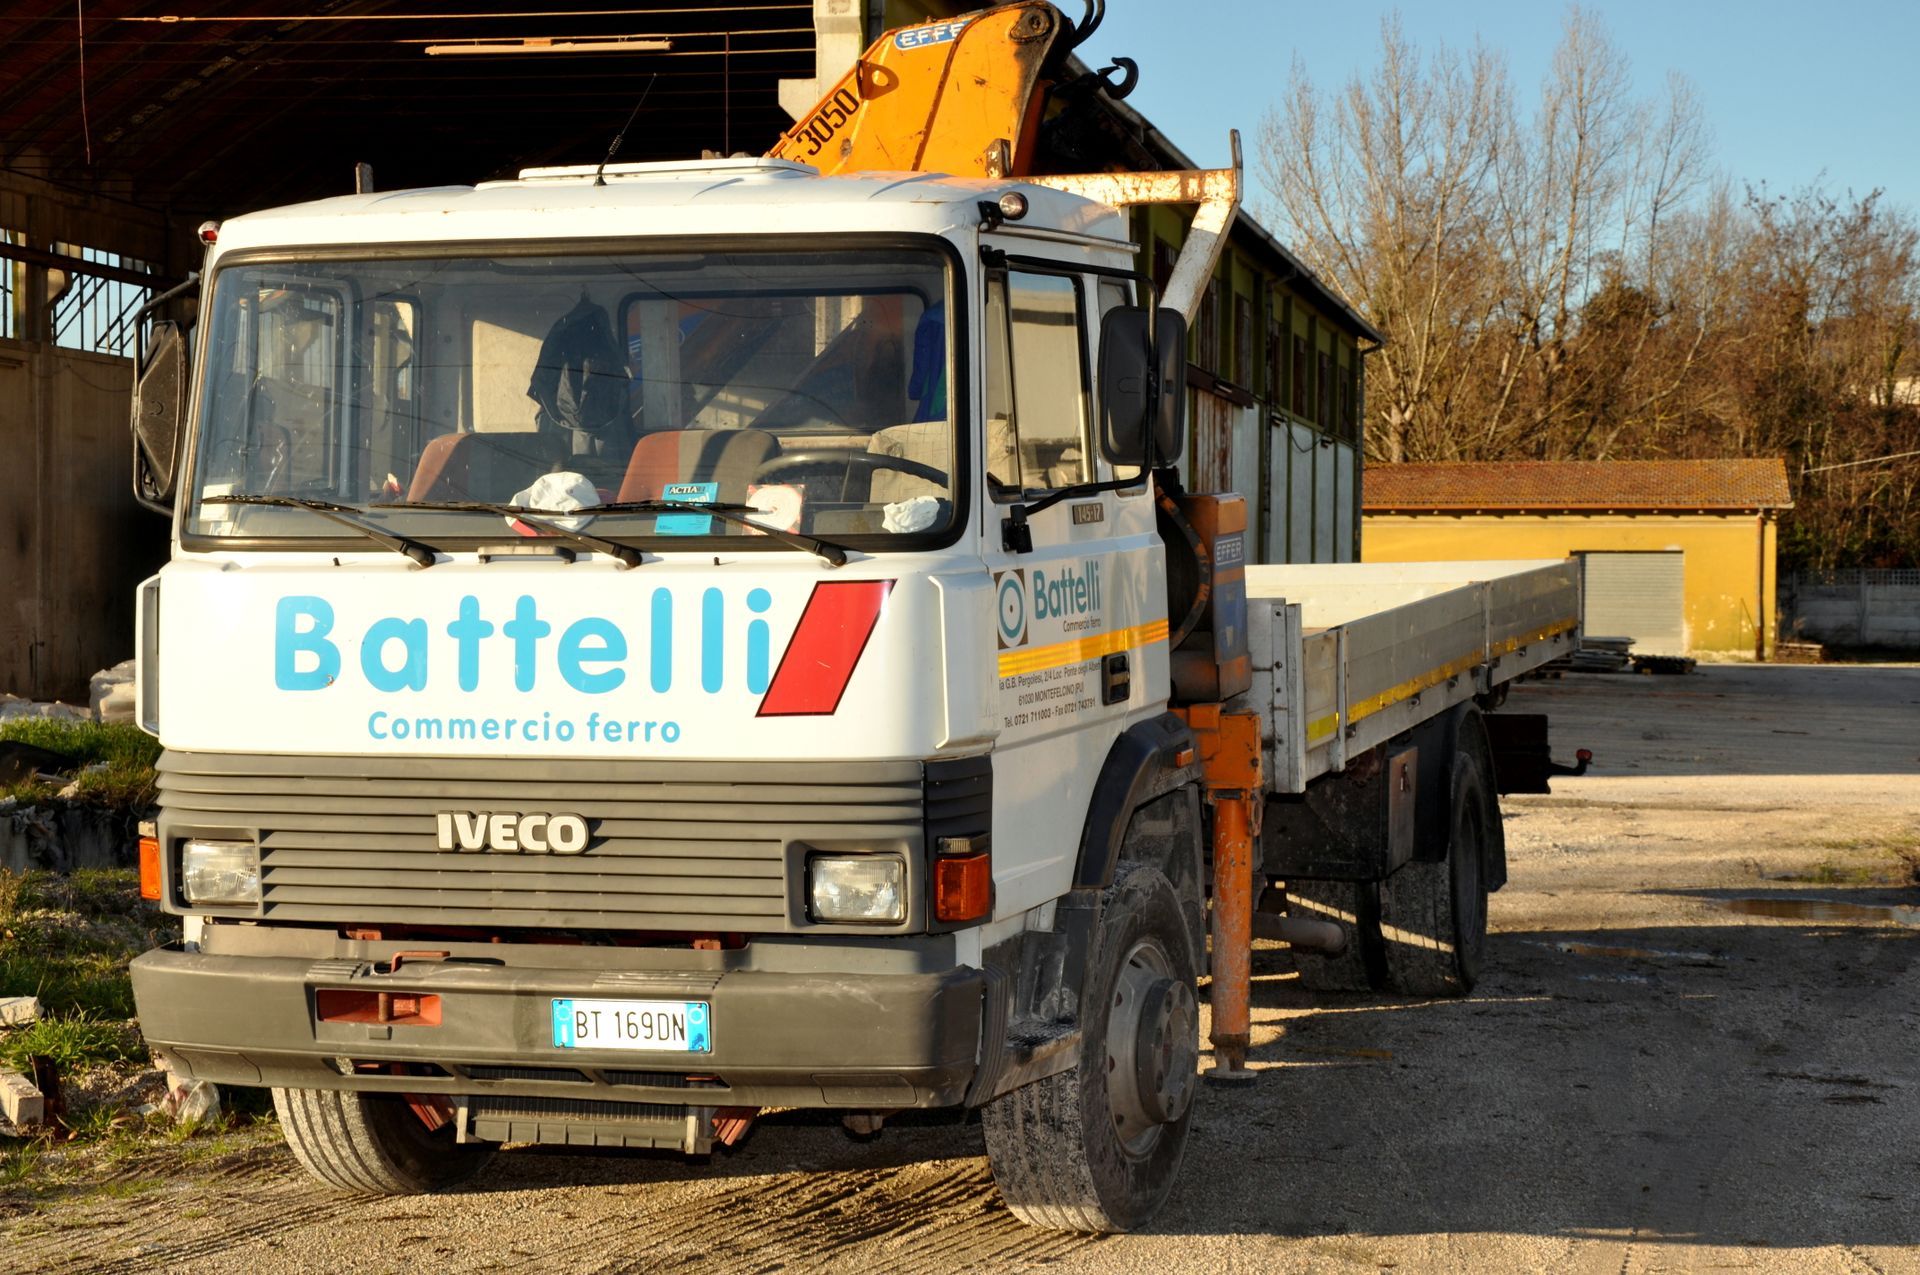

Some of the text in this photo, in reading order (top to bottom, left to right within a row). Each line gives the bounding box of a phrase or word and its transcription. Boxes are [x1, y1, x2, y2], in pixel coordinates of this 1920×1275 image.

[901, 23, 965, 46] EFFE
[796, 88, 859, 156] 3050
[669, 486, 698, 494] ACTIA
[1216, 541, 1241, 561] EFFER
[1033, 560, 1100, 619] Battelli
[1062, 617, 1089, 633] Commercio
[274, 587, 773, 695] Battelli
[1018, 693, 1035, 706] 61030
[368, 711, 681, 743] Commercio ferro
[1014, 712, 1029, 726] 0721
[437, 811, 588, 853] IVECO
[576, 1011, 685, 1041] BT 169DN
